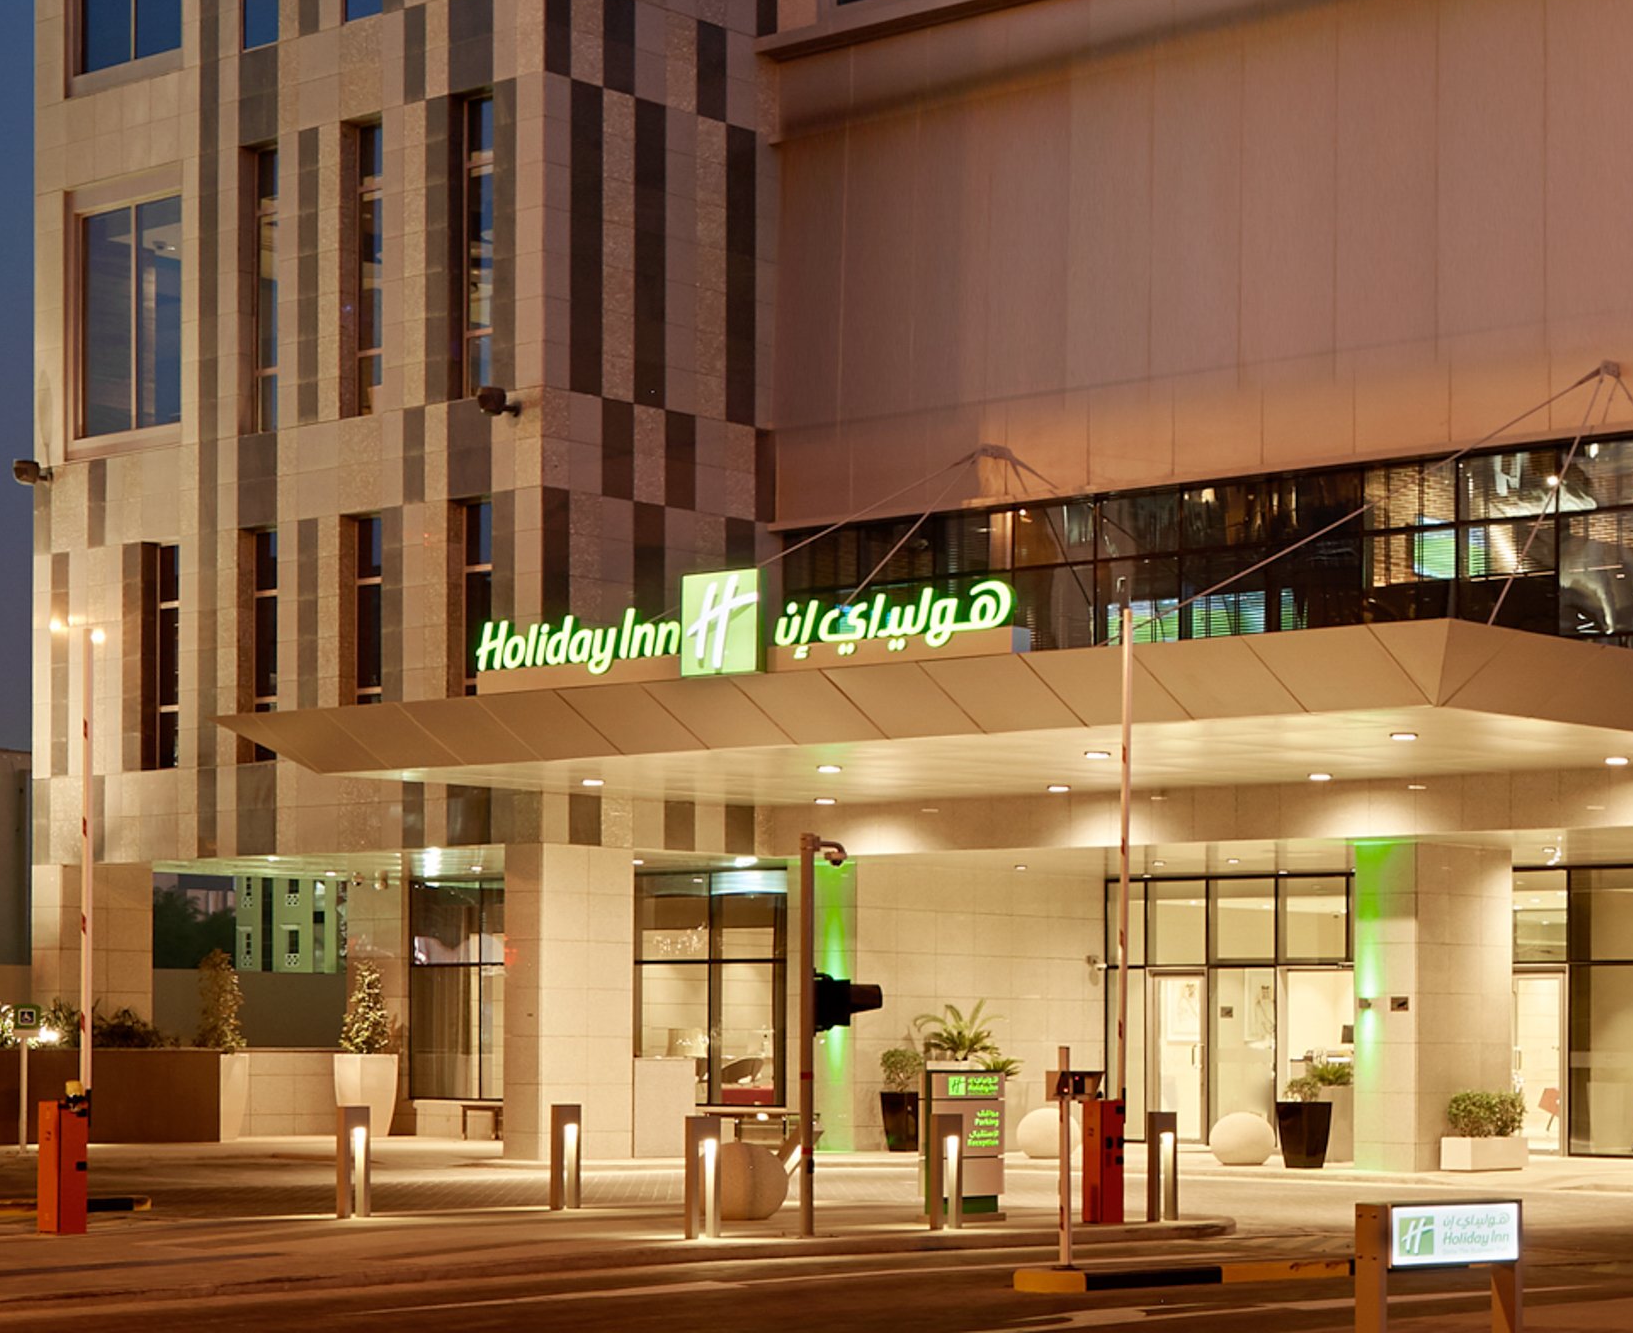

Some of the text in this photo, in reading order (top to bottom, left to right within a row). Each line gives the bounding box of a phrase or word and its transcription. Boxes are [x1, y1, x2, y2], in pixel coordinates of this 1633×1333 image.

[475, 607, 681, 675] Holiday Inn
[1443, 1229, 1510, 1247] Holiday Inn
